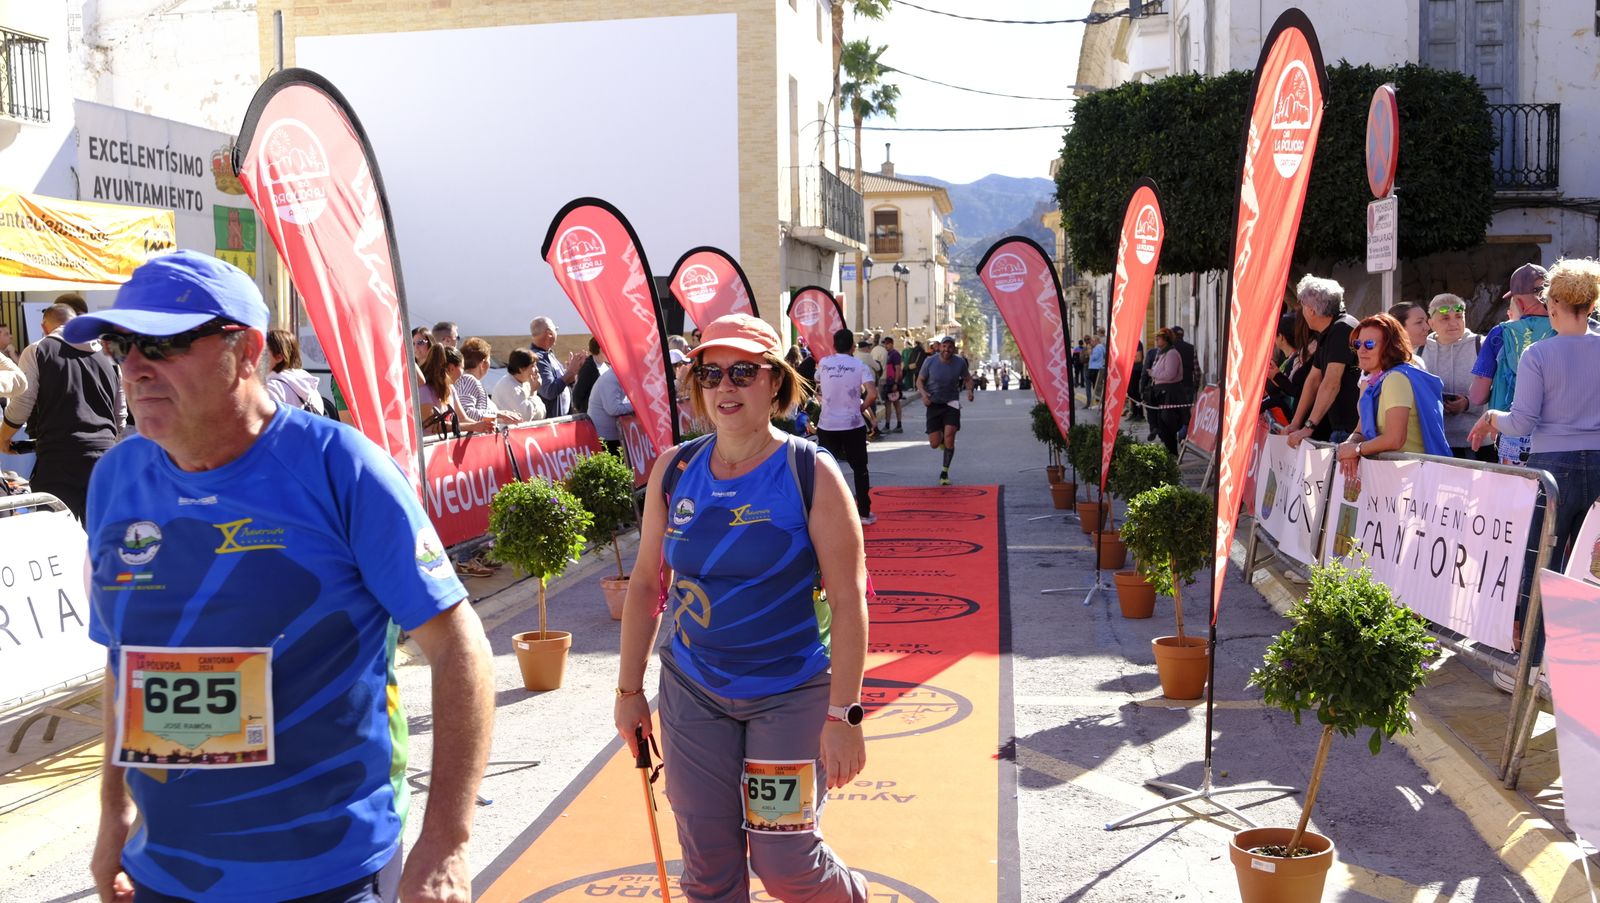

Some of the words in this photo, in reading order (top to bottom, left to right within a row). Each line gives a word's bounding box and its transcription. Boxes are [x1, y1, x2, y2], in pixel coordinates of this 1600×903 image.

[89, 136, 203, 178] EXCELENTÍSIMO
[93, 175, 203, 211] AYUNTAMIENTO
[545, 445, 592, 482] VEO
[427, 465, 501, 518] VEOLIA
[1492, 518, 1513, 543] DE
[28, 555, 63, 581] DE
[1360, 520, 1509, 602] CANTORIA
[145, 677, 237, 715] 625
[747, 777, 797, 802] 657
[853, 780, 897, 790] de
